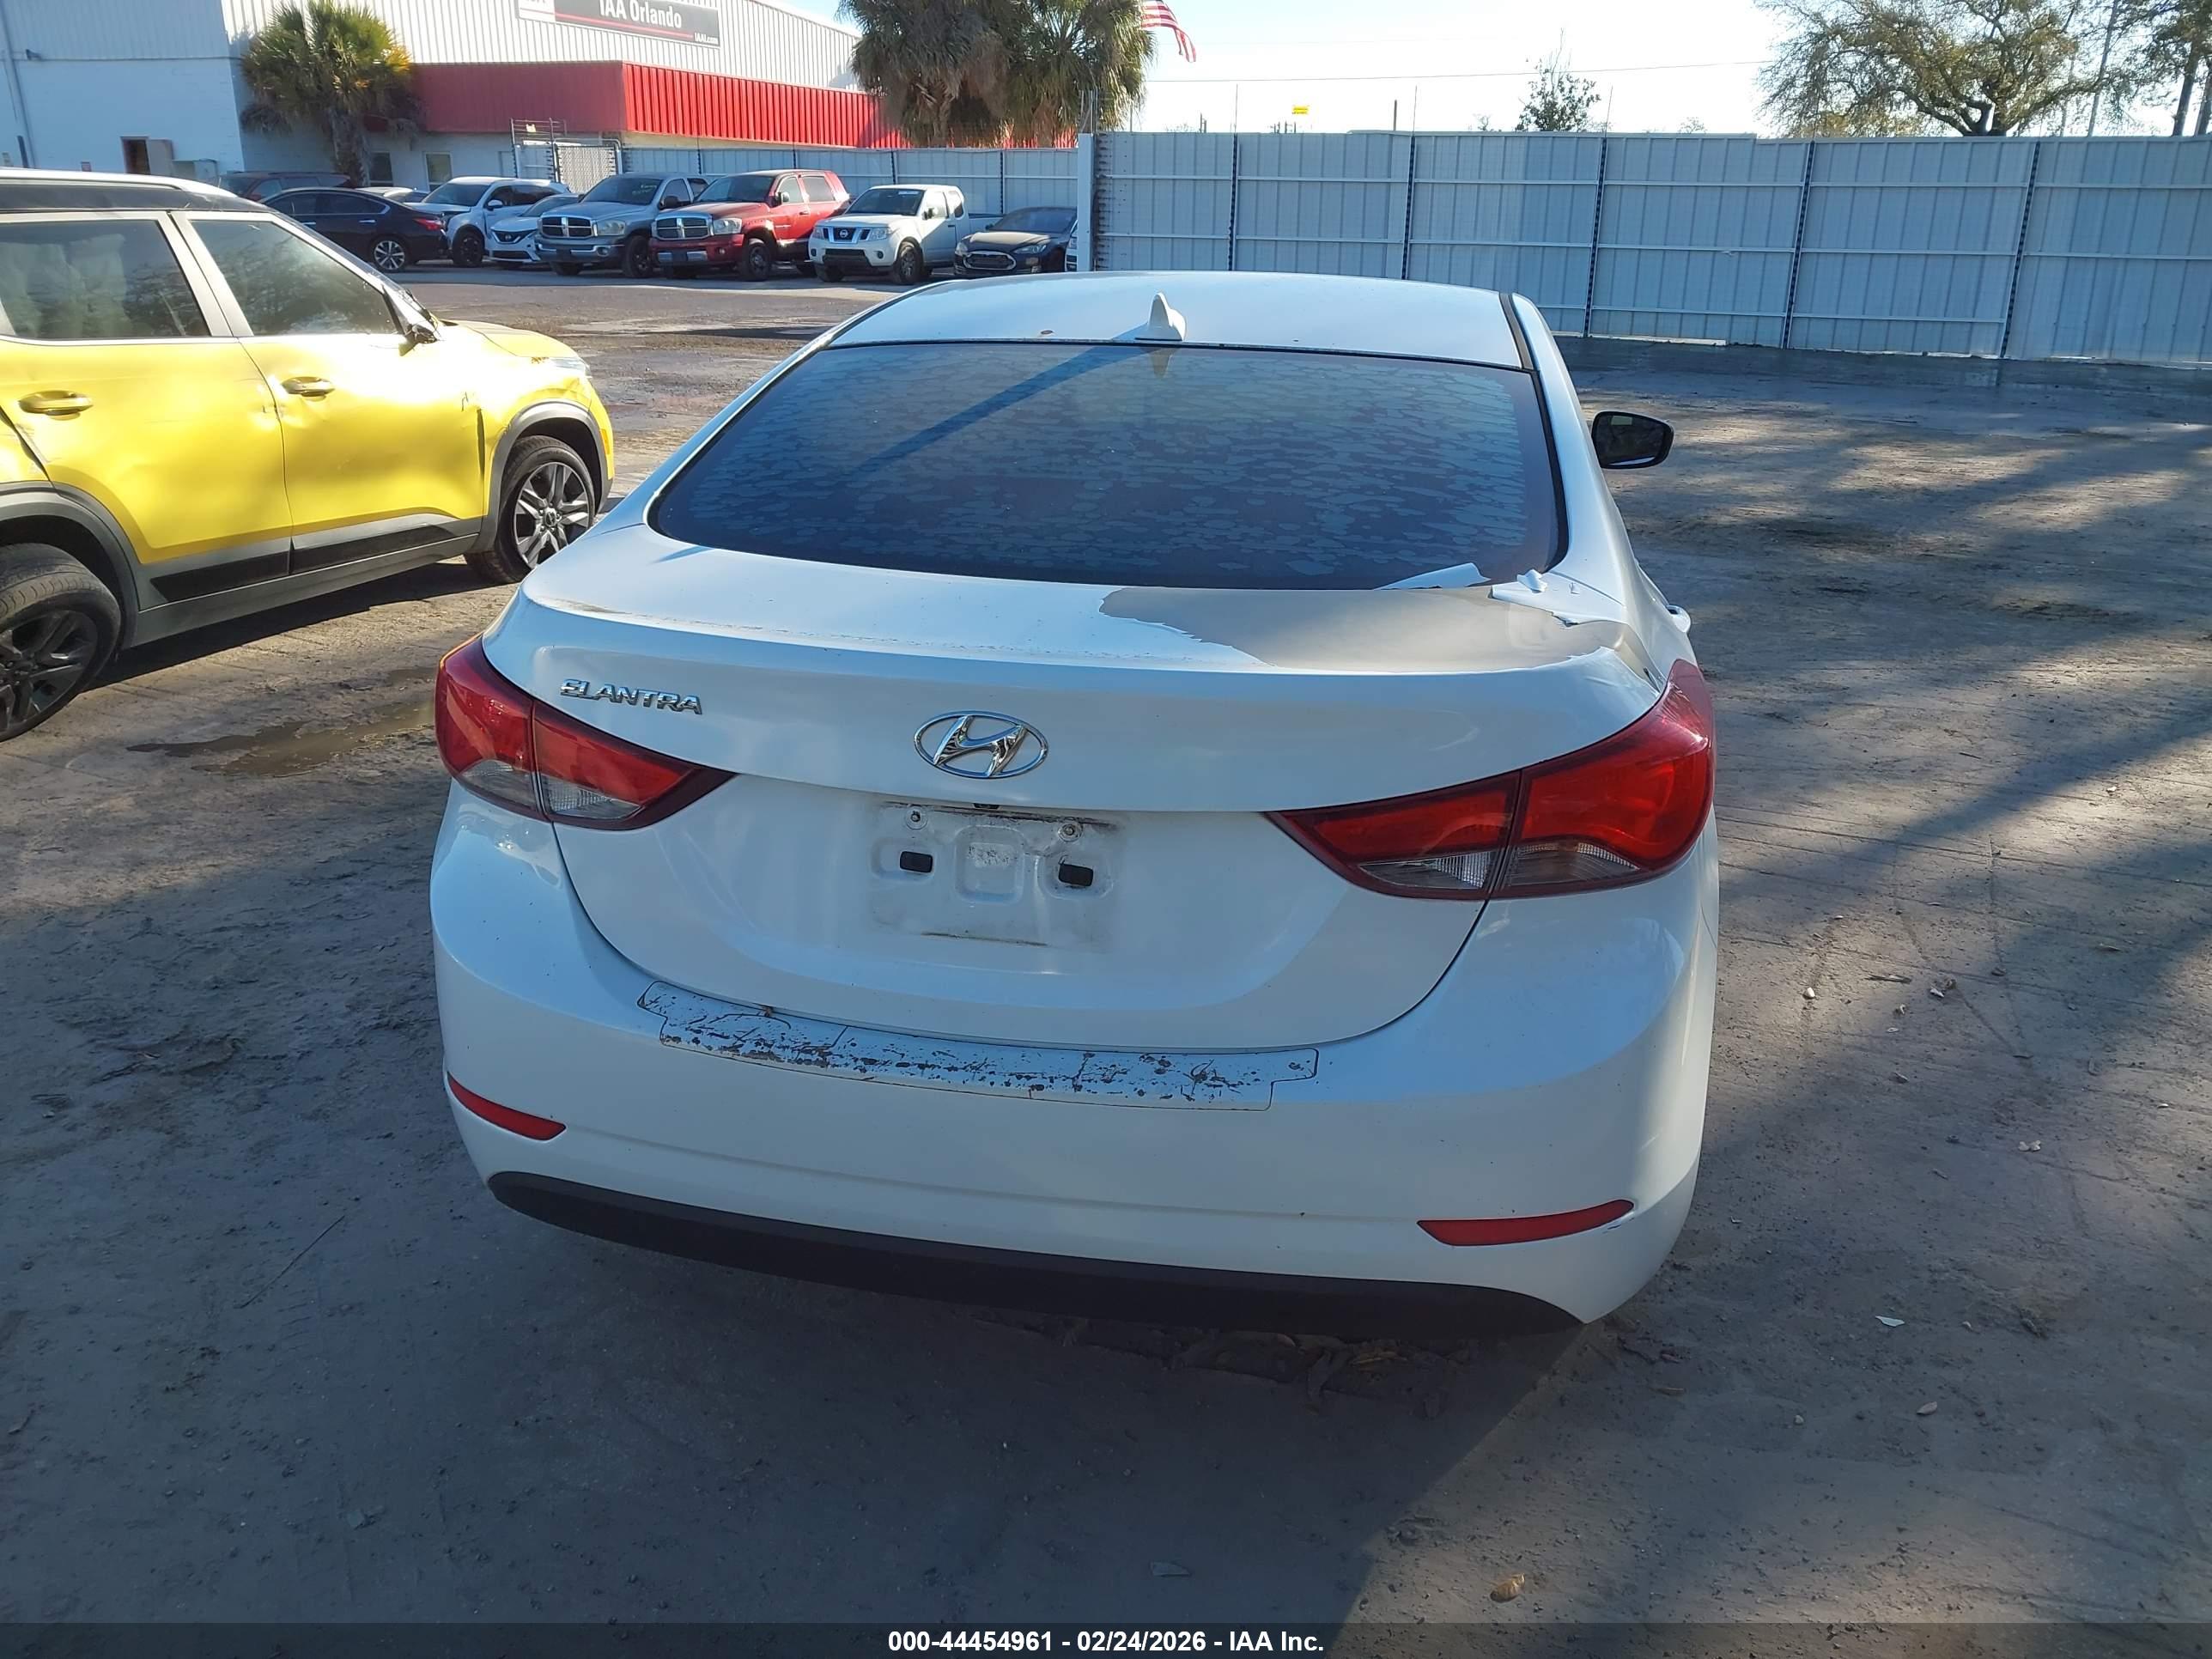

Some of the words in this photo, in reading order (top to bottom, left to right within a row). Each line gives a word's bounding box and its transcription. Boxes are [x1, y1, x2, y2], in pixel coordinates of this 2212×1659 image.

[599, 0, 627, 20] IAA
[629, 0, 682, 28] Orlando
[560, 678, 702, 714] ELANTRA
